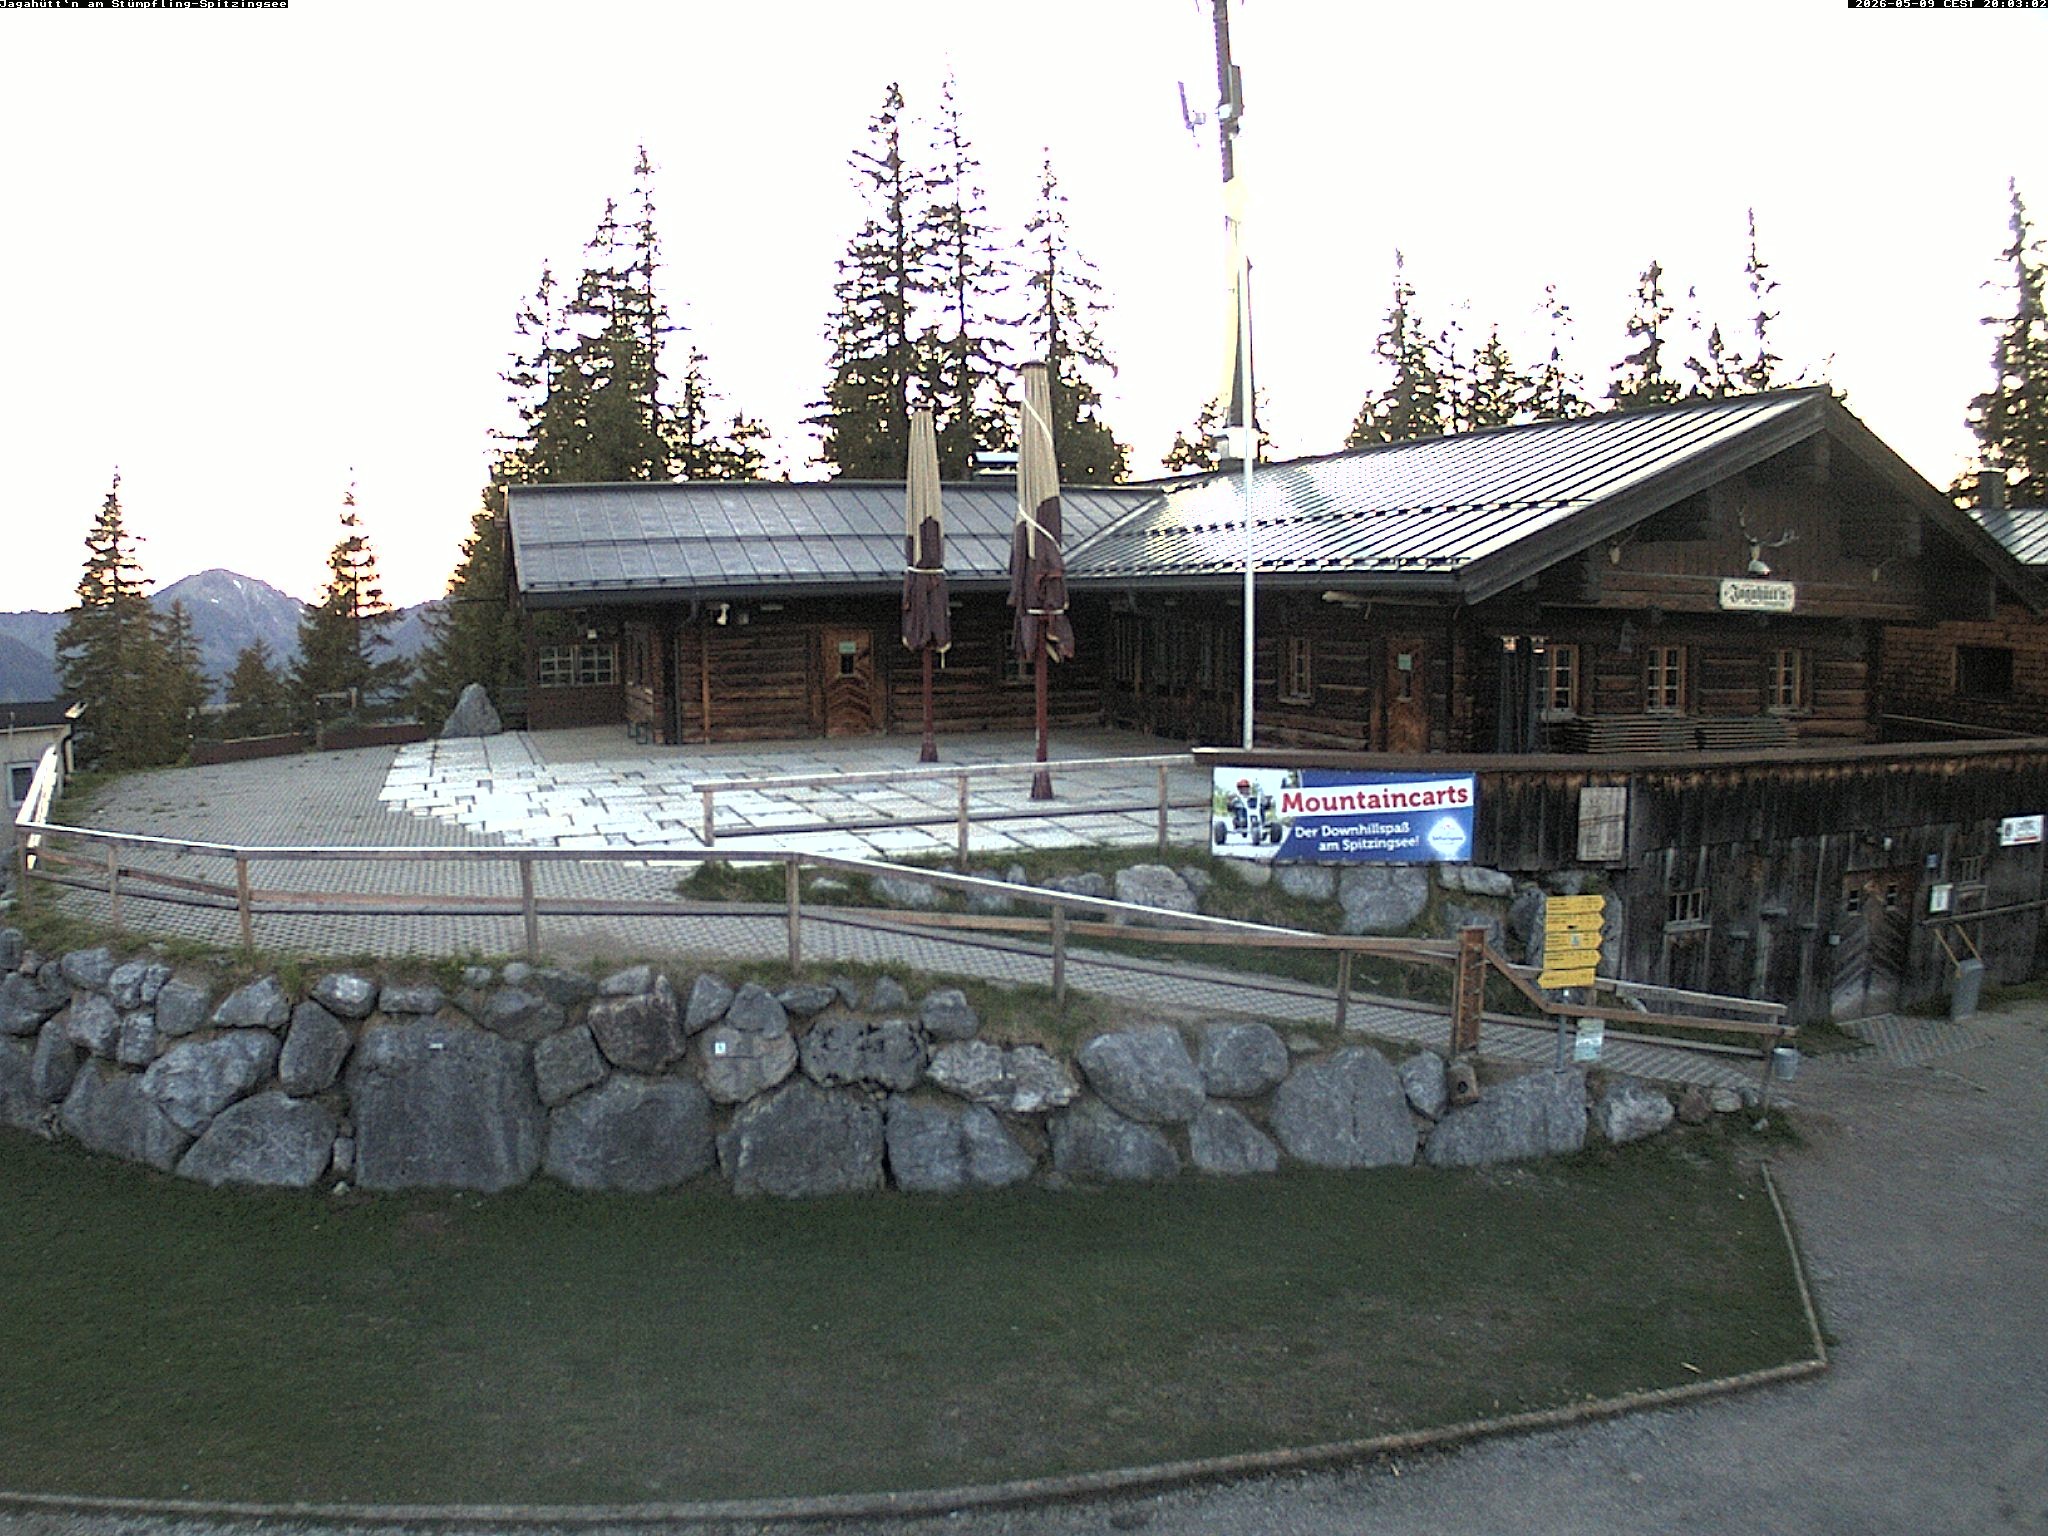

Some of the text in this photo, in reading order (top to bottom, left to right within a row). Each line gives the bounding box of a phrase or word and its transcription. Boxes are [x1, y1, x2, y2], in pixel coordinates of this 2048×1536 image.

[1281, 785, 1468, 813] Mountaincarts
[1295, 821, 1410, 838] Der Downhillspaß
[1318, 835, 1420, 853] am Spitzingsee!
